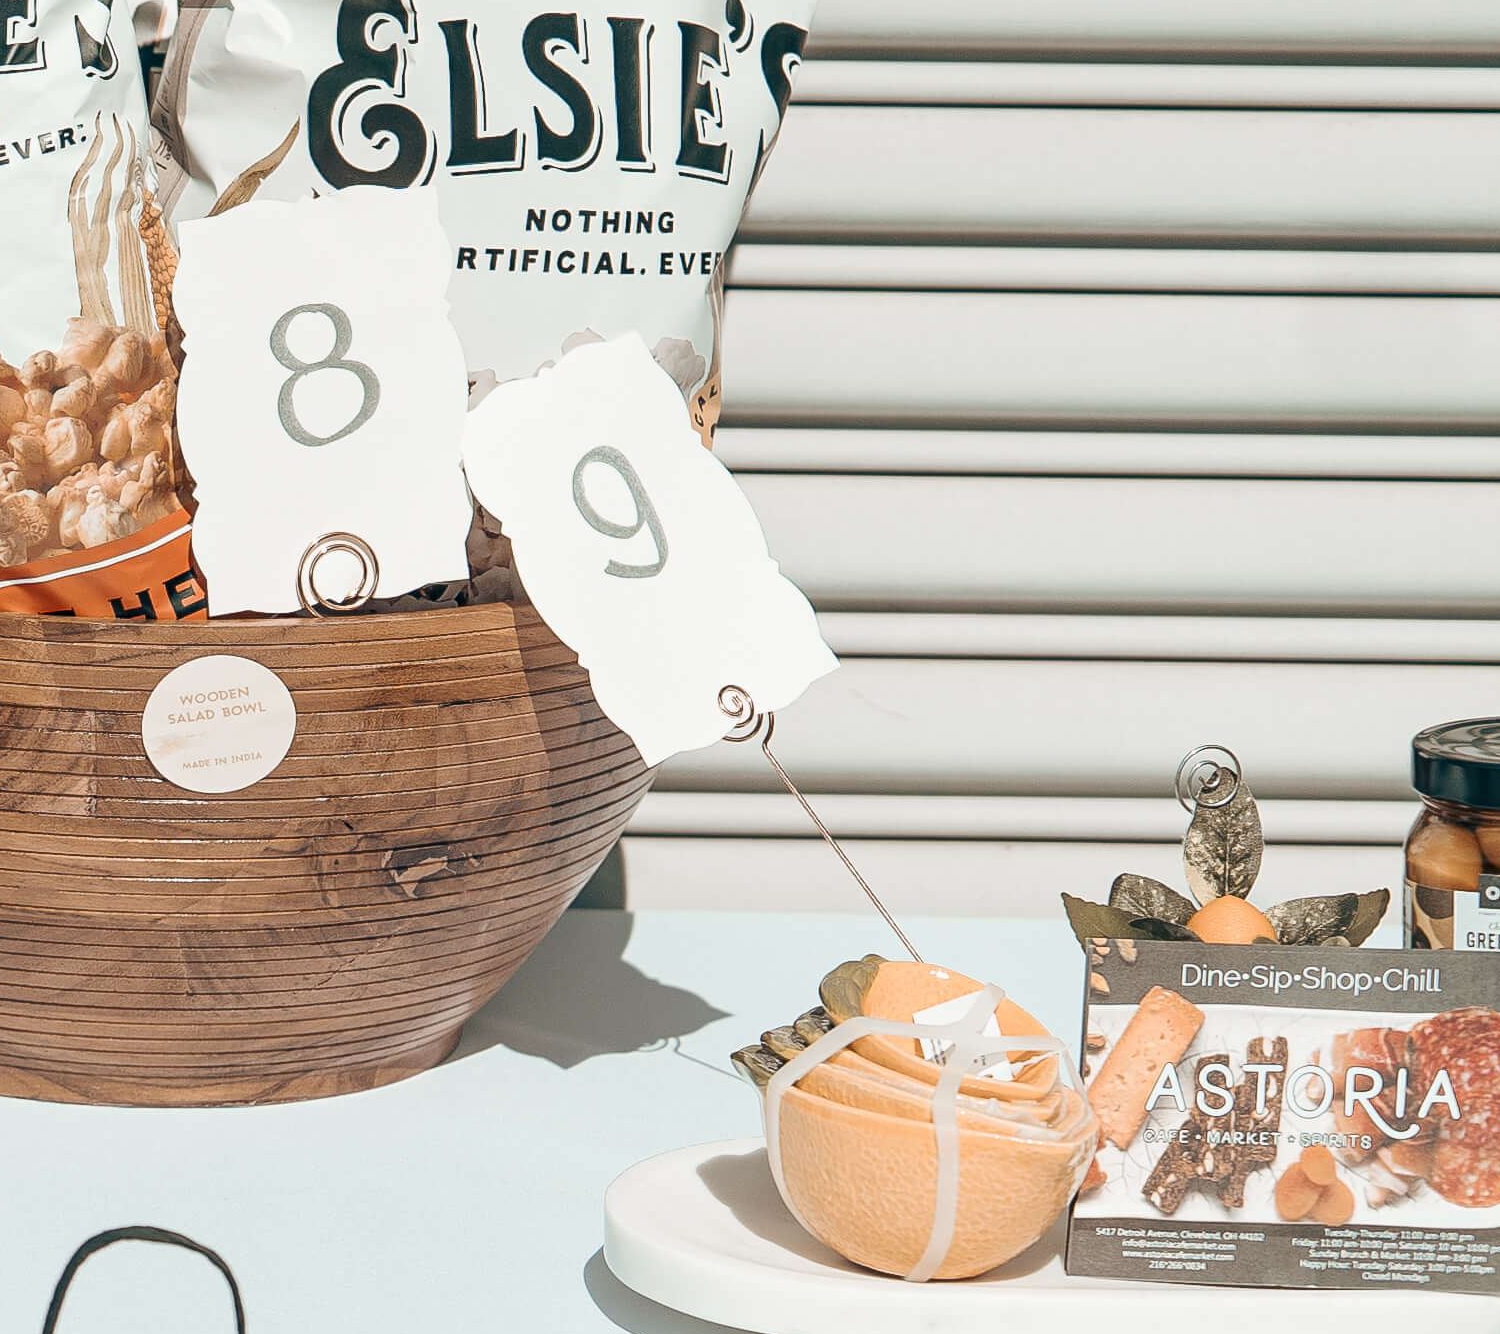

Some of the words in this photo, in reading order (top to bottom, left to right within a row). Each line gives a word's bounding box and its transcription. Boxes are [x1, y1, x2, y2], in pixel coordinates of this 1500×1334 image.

[524, 208, 675, 235] NOTHING
[455, 247, 647, 276] RTIFICIAL.
[269, 302, 381, 447] 8
[572, 444, 669, 580] 9
[179, 686, 250, 706] WOODEN
[167, 709, 215, 725] SALAD
[222, 701, 267, 718] BOWL
[182, 758, 211, 770] MADE
[215, 756, 228, 767] IN
[231, 751, 263, 764] INDIA
[1144, 1061, 1462, 1141] ASTORIA
[1142, 1128, 1190, 1144] CAFE
[1206, 1130, 1281, 1147] MARKET
[1299, 1132, 1373, 1150] SPIRITS
